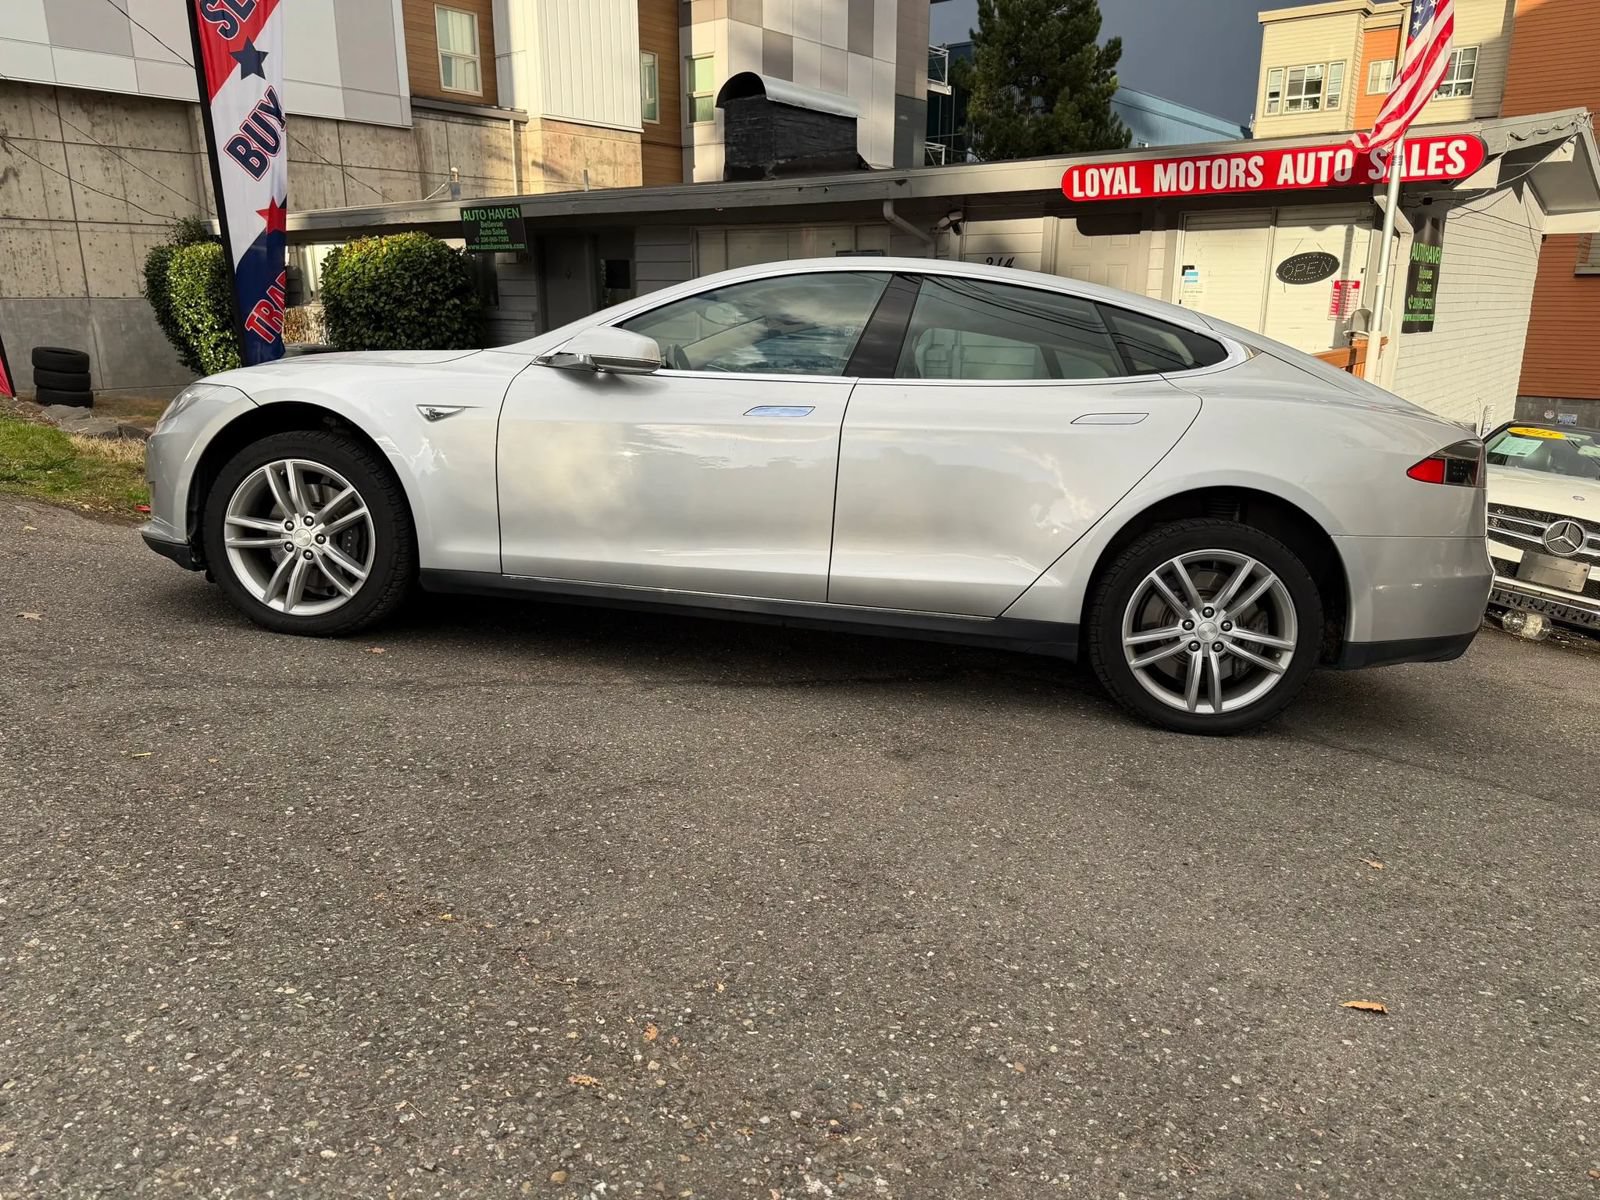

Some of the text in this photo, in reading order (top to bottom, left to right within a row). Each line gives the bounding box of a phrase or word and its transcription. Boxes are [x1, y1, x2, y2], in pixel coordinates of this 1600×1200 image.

[223, 85, 287, 181] BUY
[1072, 166, 1142, 198] LOYAL
[1153, 155, 1264, 193] MOTORS
[1276, 149, 1354, 186] AUTO
[463, 207, 520, 221] AUTO HAVEN
[1282, 259, 1333, 278] OPEN
[245, 270, 286, 343] TRA
